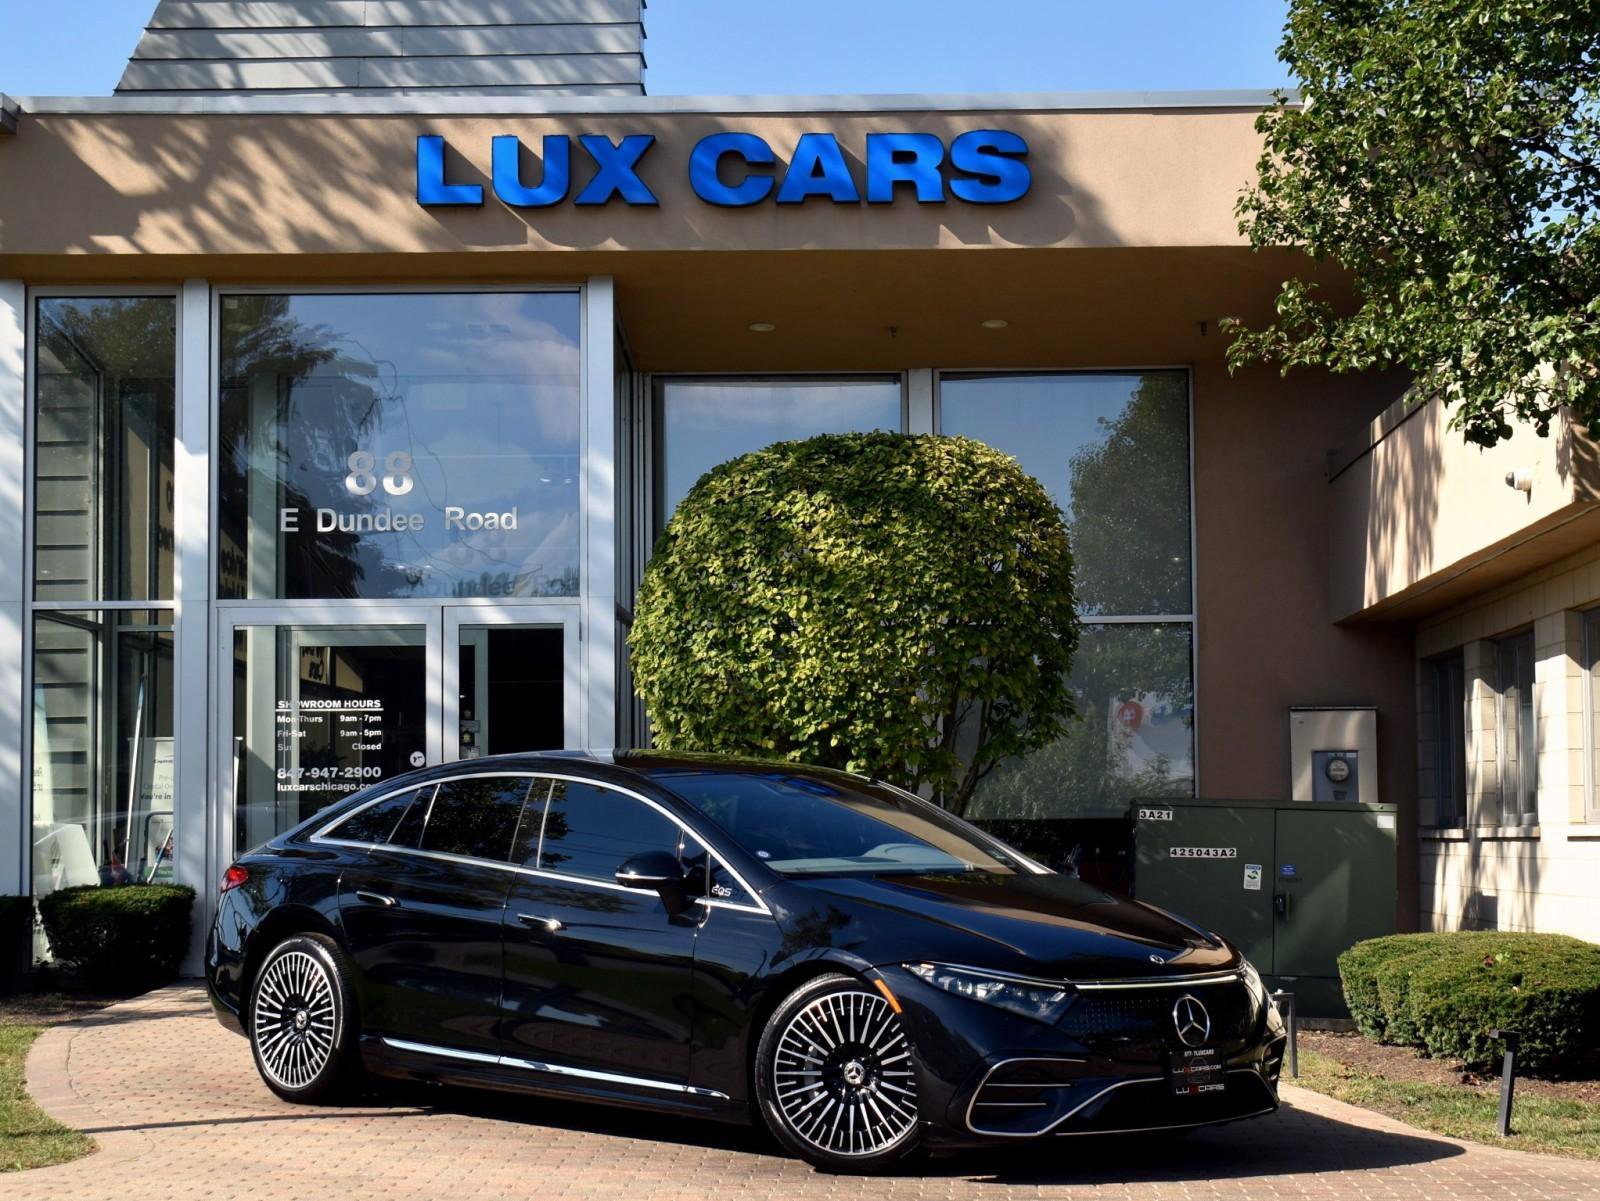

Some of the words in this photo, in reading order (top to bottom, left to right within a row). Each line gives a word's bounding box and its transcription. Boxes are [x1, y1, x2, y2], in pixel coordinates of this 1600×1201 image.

[416, 134, 659, 206] LUX
[688, 129, 1032, 206] CARS
[345, 450, 414, 496] 88
[280, 508, 299, 532] E
[316, 507, 425, 533] Dundee
[445, 506, 519, 531] Road
[277, 700, 342, 709] SHWROOM
[343, 699, 382, 708] HOURS
[276, 715, 324, 723] Mon-Thurs
[339, 714, 358, 722] 9am
[363, 714, 382, 723] 7pm
[276, 729, 307, 738] Fri-Sat
[363, 729, 382, 738] 5pm
[351, 742, 382, 750] Closed
[276, 781, 377, 792] luxcarschicago.co
[1139, 810, 1172, 820] 3A21
[1170, 848, 1236, 857] 425043A2
